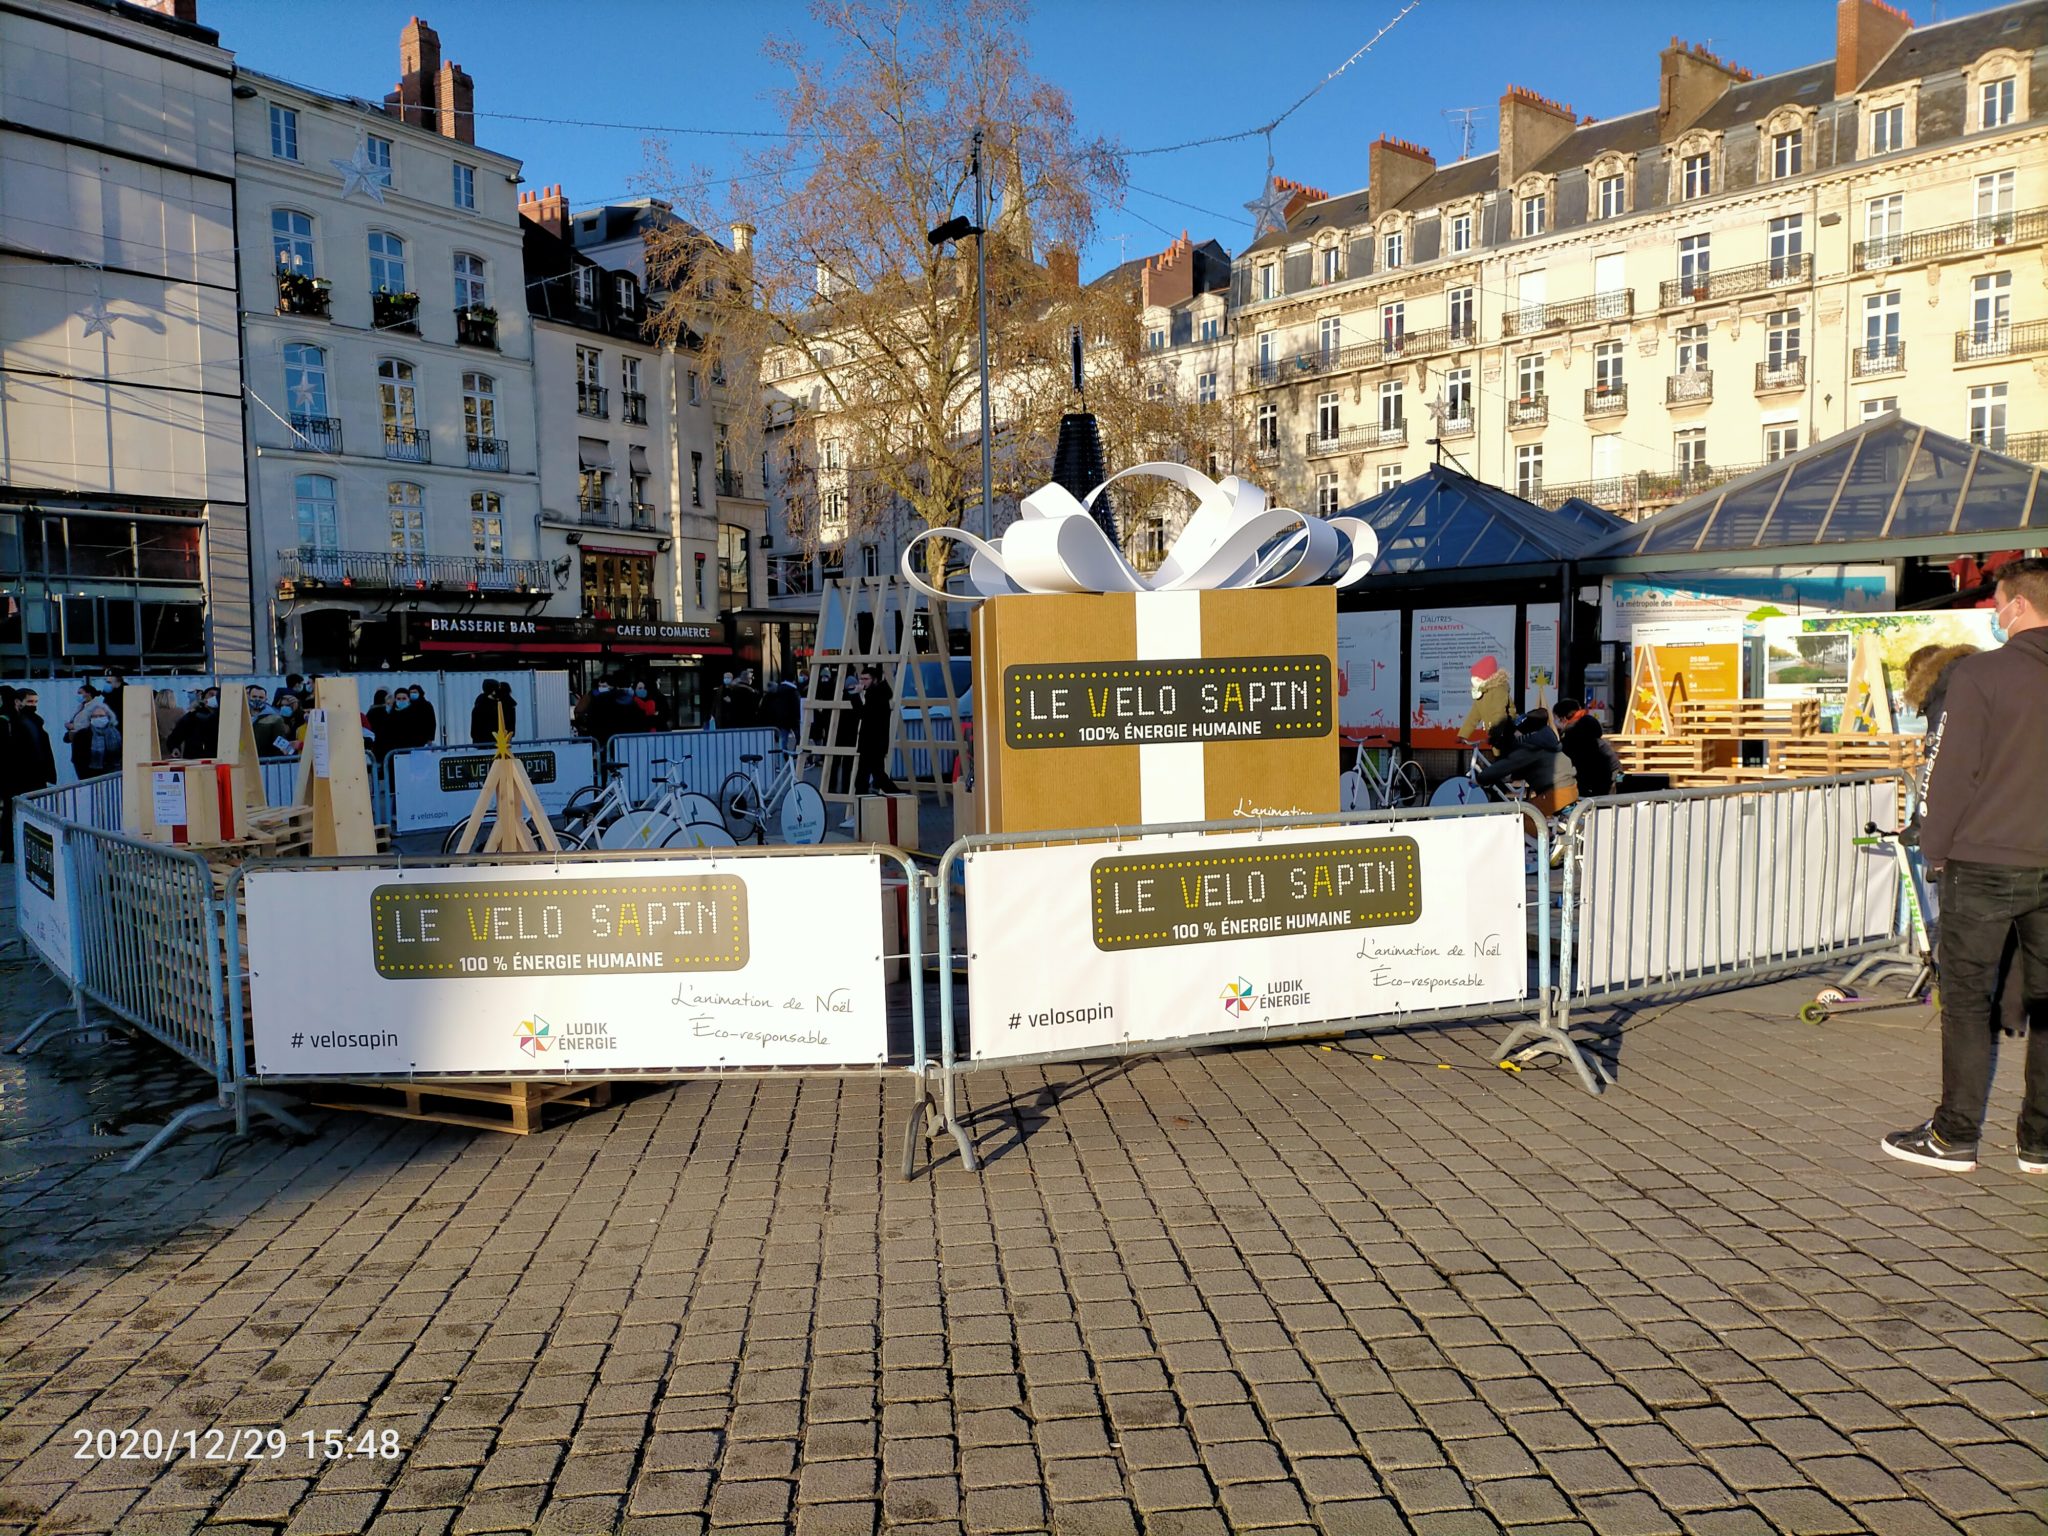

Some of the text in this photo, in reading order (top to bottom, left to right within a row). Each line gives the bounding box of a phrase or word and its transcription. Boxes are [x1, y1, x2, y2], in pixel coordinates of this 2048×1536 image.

[431, 619, 536, 634] BRASSERIE BAR
[644, 626, 658, 637] DU
[660, 626, 710, 638] COMMERCE
[1420, 624, 1464, 632] ALTERNATIVES
[1030, 680, 1309, 720] LE VELO SAPIN
[1078, 720, 1262, 742] 100% ÉNERGIE HUMAINE
[1920, 710, 1949, 801] carhartt
[446, 766, 463, 779] LE
[470, 763, 490, 778] VEL
[1113, 860, 1396, 915] LE VELO SAPIN
[395, 899, 718, 943] LE VELO SAPIN
[1172, 910, 1352, 940] 100 % ÉNERGIE HUMAINE
[1356, 933, 1502, 960] L'animation de Noël
[459, 950, 664, 973] 100 % ÉNERGIE HUMAINE
[1267, 980, 1304, 994] LUDIK
[1370, 963, 1485, 992] Éco-responsable
[672, 982, 855, 1014] L'animation de Noël
[1259, 988, 1312, 1010] ÉNERGIE
[566, 1022, 608, 1036] LUDIK
[1008, 1003, 1114, 1030] # velosapin
[291, 1029, 399, 1054] # velosapin
[558, 1032, 618, 1050] ÉNERGIE
[688, 1012, 832, 1049] Éco-responsable
